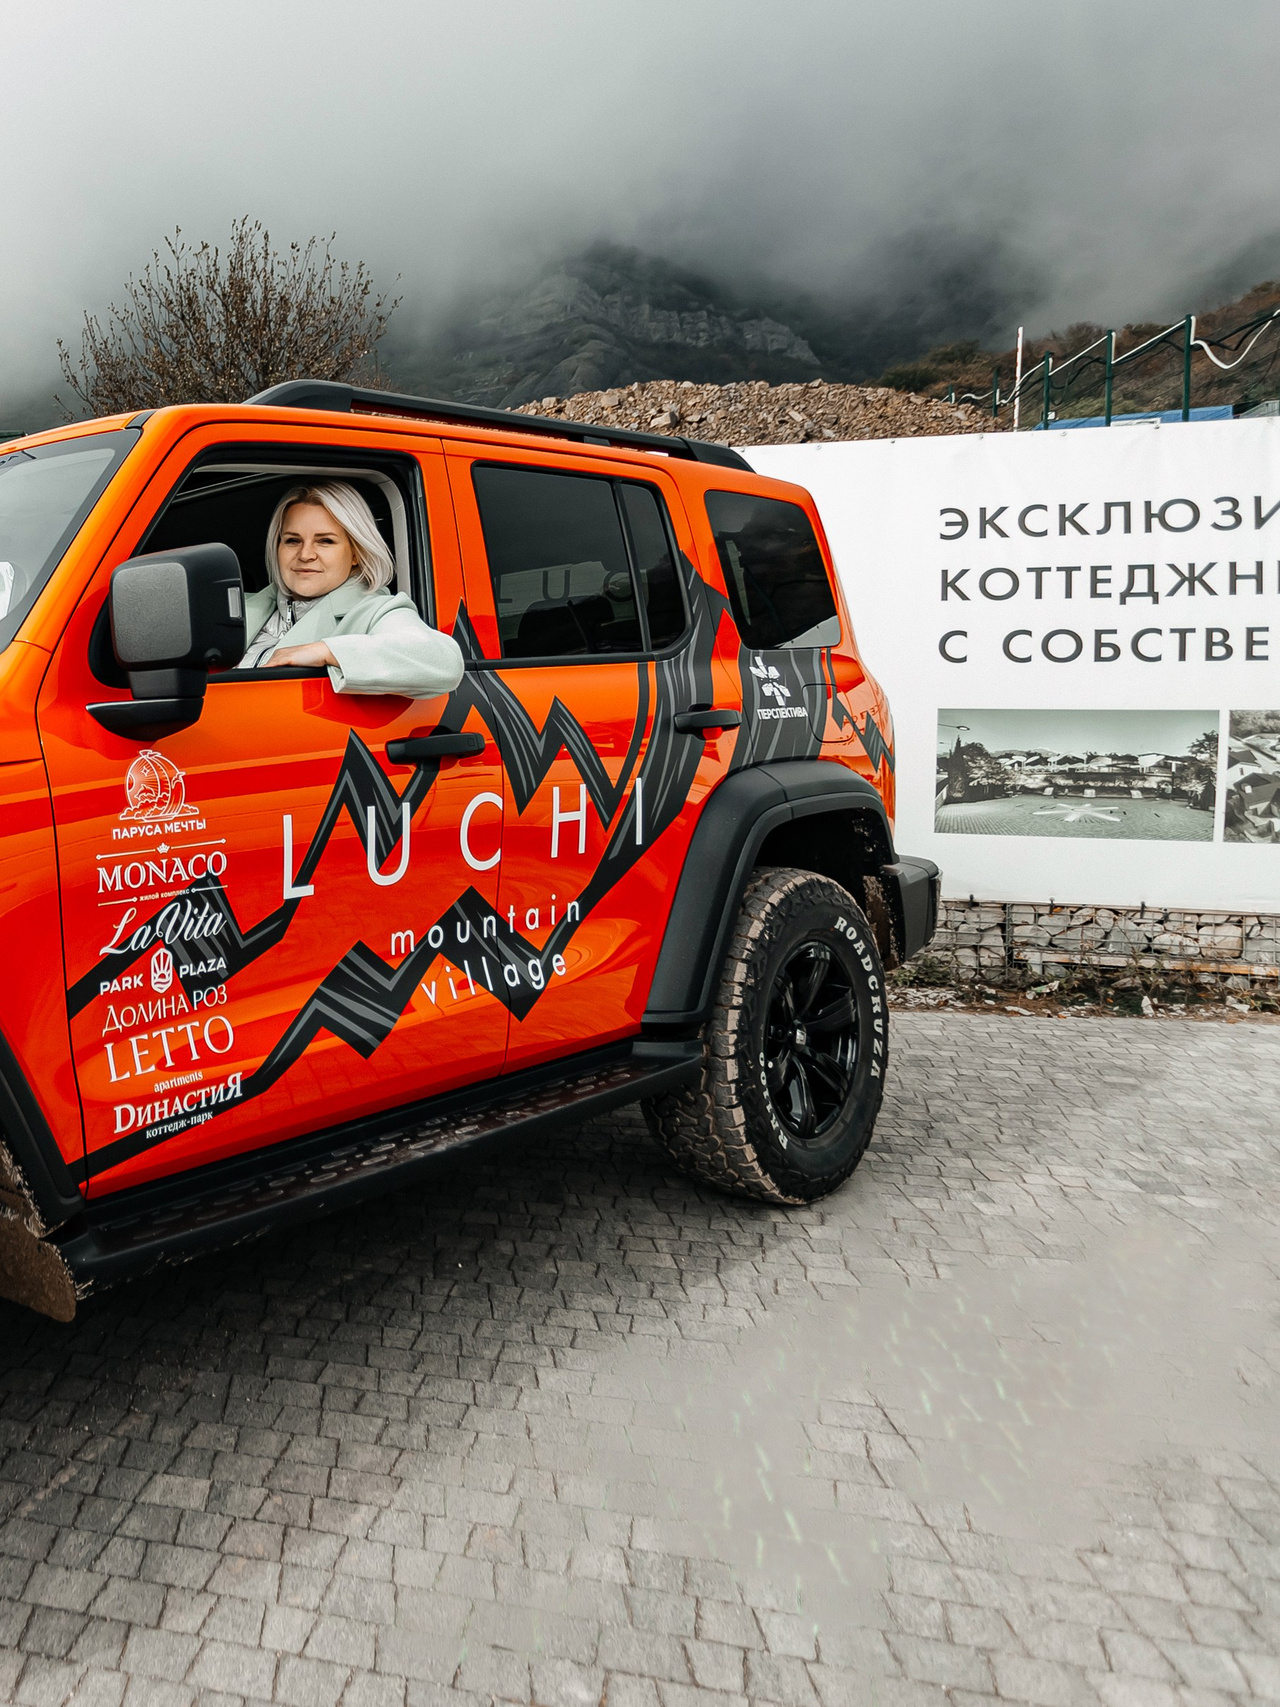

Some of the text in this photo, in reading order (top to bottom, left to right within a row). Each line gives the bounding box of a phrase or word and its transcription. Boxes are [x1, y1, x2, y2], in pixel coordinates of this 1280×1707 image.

[940, 560, 1280, 605] КОТТЕДЖН
[938, 626, 1270, 664] С СОБСТВЕ
[756, 706, 809, 720] ПЕРСПЕКТИВА
[111, 818, 207, 840] ПАРУСА МЕЧТЫ
[283, 777, 643, 900] LUCHI
[97, 851, 228, 894] MONACO
[99, 899, 228, 957] La Vita
[390, 894, 580, 956] mountain
[99, 957, 227, 996] PARK PLAZA
[421, 951, 567, 1005] village
[834, 915, 884, 1080] ROADCRUZA
[102, 984, 228, 1037] ДОЛИНА РОЗ
[104, 1015, 234, 1083] LETTO
[153, 1071, 204, 1093] apartments
[145, 1111, 214, 1139] коттедж-парк
